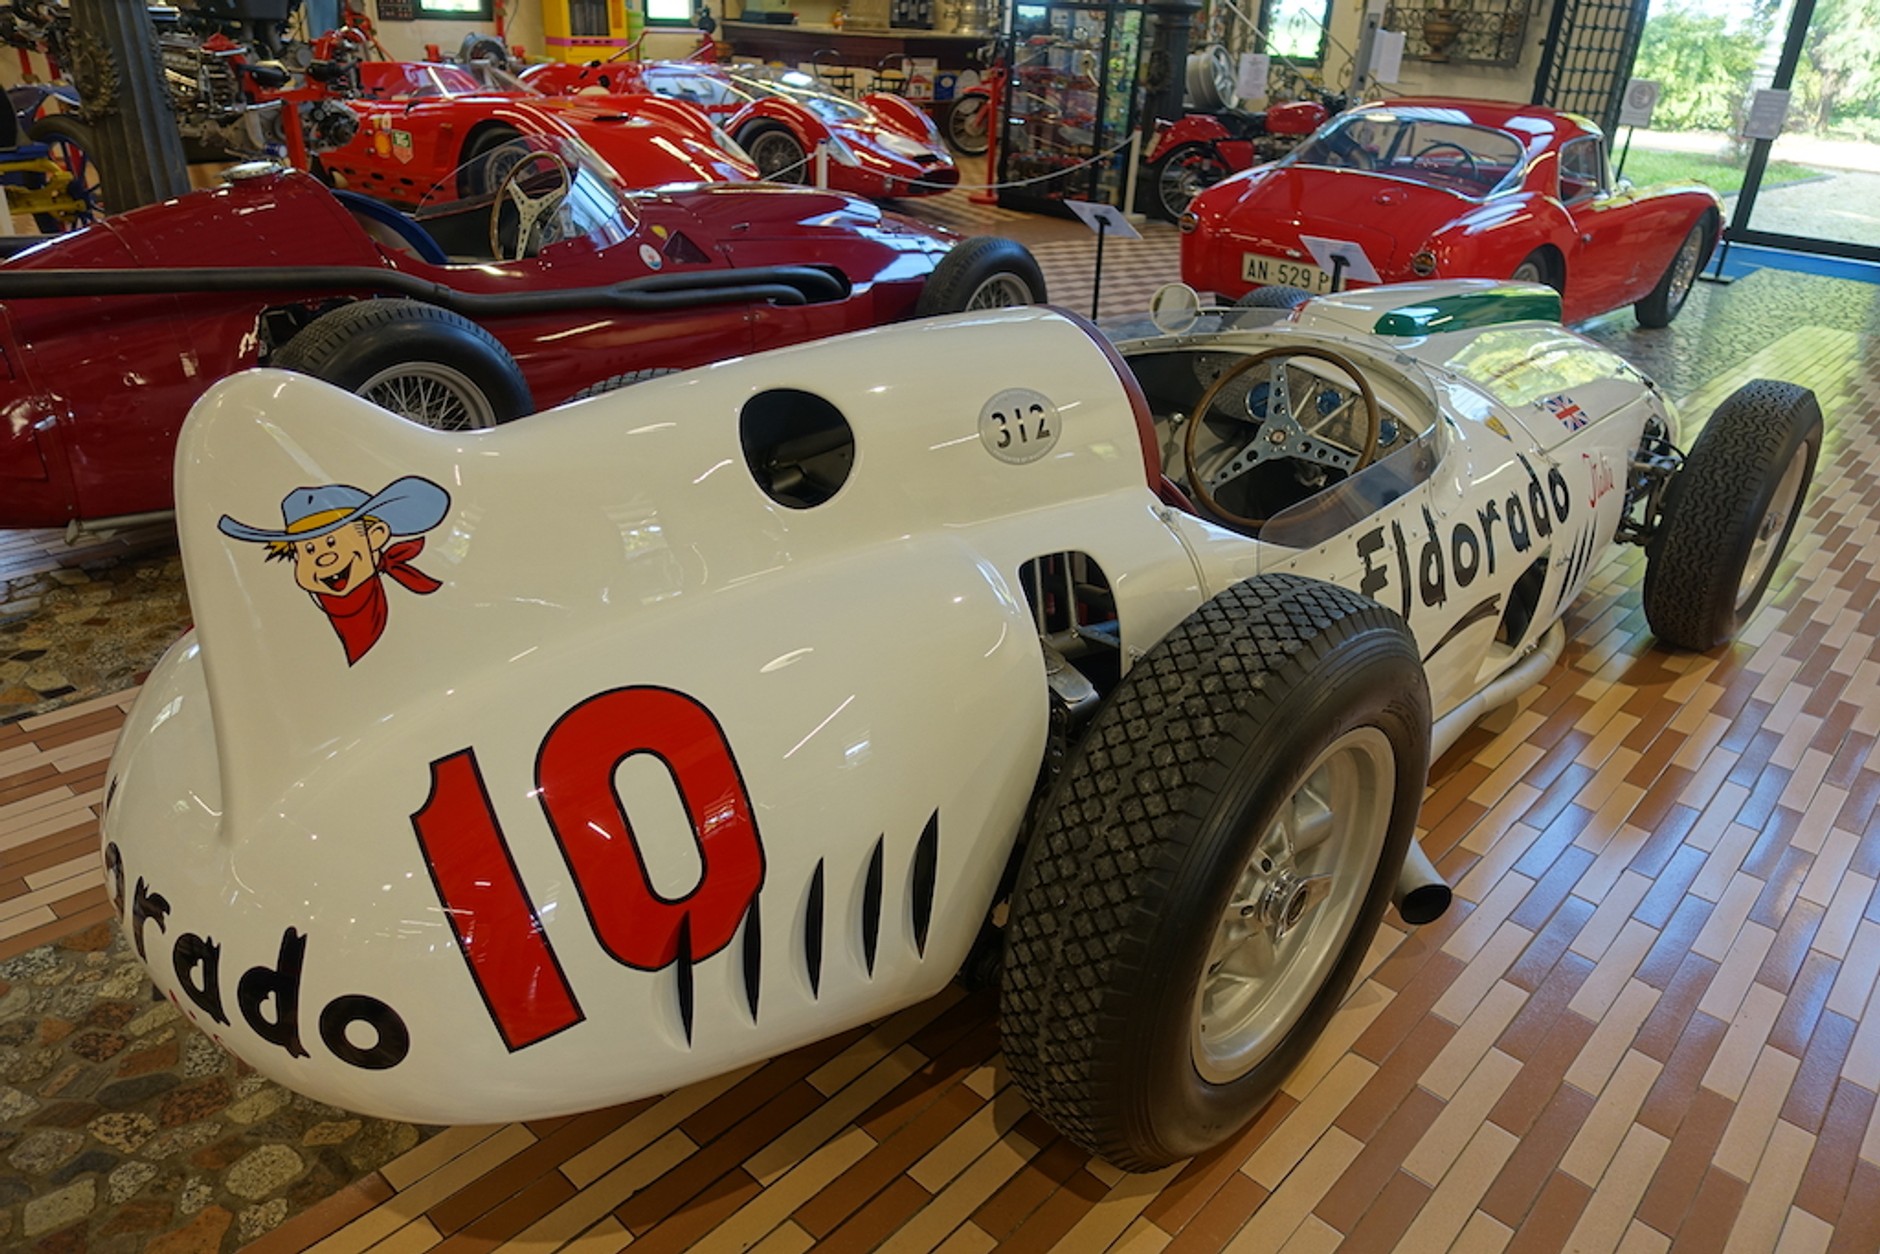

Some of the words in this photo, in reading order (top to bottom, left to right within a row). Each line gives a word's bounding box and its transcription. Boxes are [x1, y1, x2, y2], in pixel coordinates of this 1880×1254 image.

[1247, 259, 1268, 281] AN
[1278, 264, 1311, 289] 529
[991, 403, 1051, 449] 312
[1356, 452, 1570, 624] Eldorado
[410, 684, 767, 1053] 10
